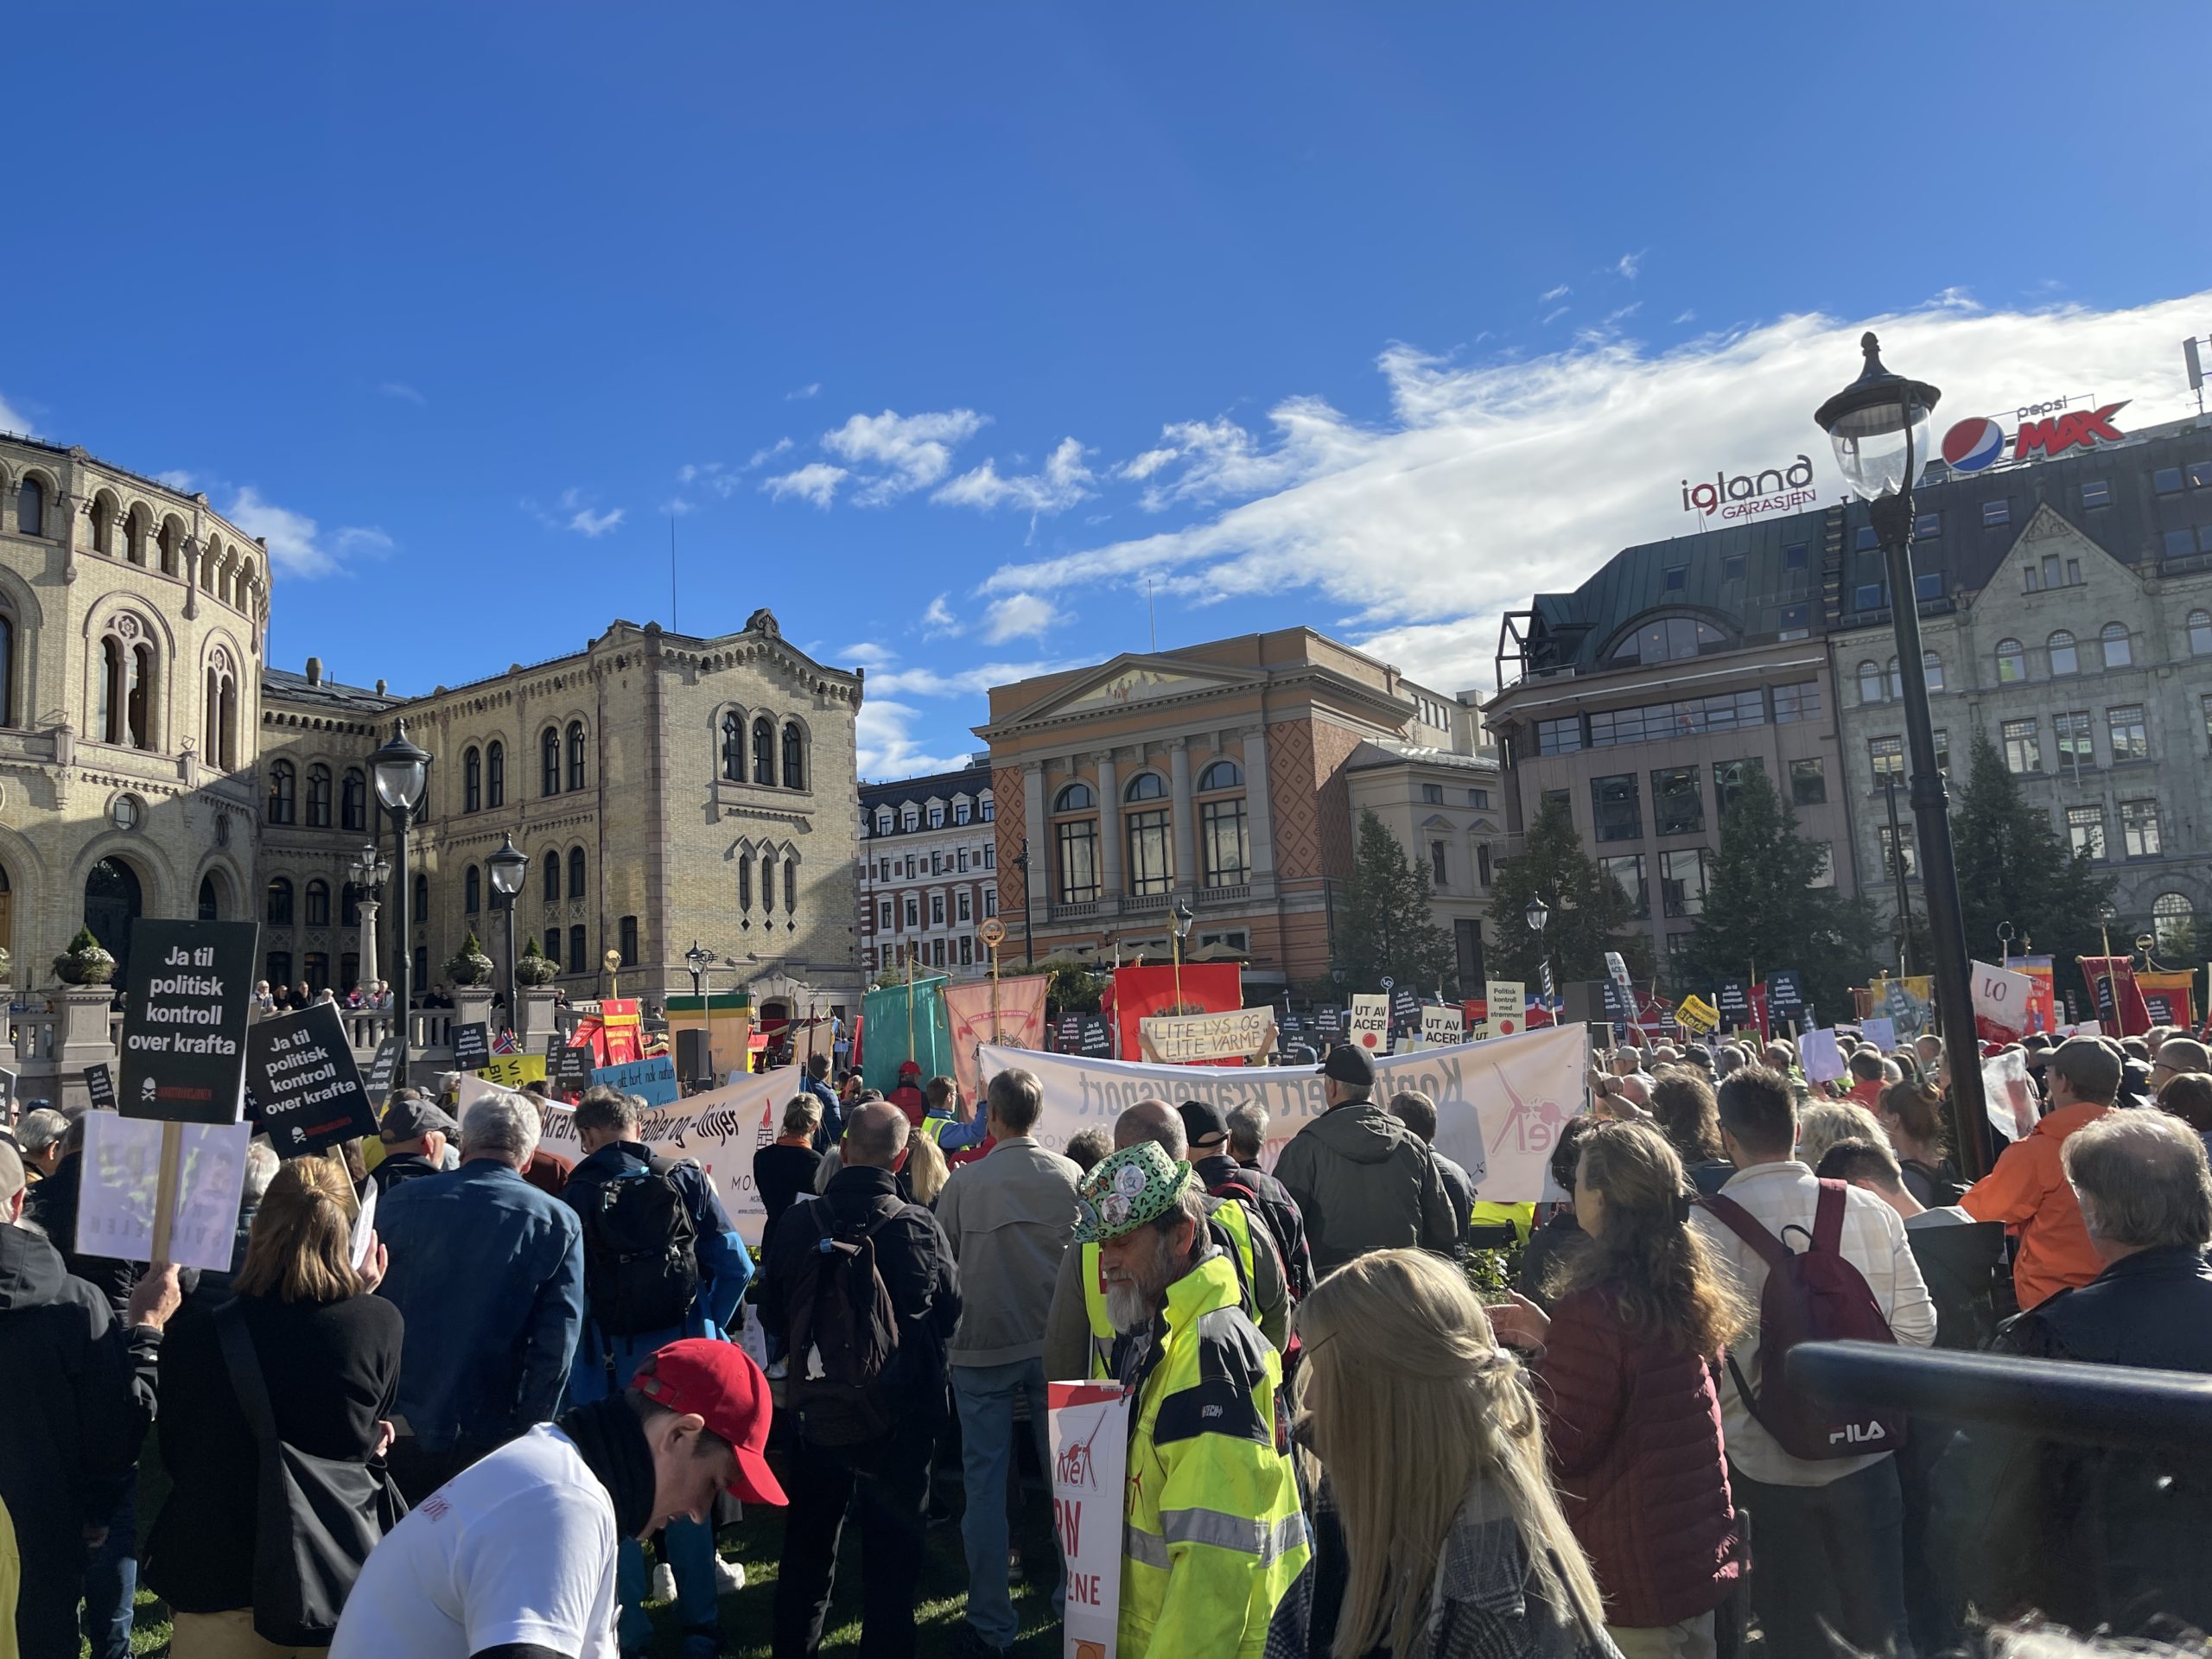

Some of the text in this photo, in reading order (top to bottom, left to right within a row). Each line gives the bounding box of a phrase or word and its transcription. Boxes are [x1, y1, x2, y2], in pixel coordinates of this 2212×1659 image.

[2017, 395, 2068, 422] pepsi
[2014, 399, 2133, 461] MAX
[1681, 454, 1814, 516] igland
[1722, 489, 1816, 519] GARASJEN
[165, 946, 214, 967] Ja til
[150, 975, 224, 997] politisk
[1985, 977, 2006, 1001] LO
[146, 1002, 222, 1025] kontroll
[1355, 1006, 1386, 1017] UT AV
[1084, 1028, 1103, 1037] politisk
[1204, 1018, 1231, 1036] LYS
[1241, 1014, 1259, 1032] OG
[1353, 1019, 1386, 1030] ACER!
[1426, 1018, 1459, 1031] UT AV
[1476, 1032, 1488, 1040] UT
[128, 1033, 236, 1055] over krafta
[270, 1028, 311, 1052] Ja til
[1166, 1039, 1205, 1057] LITE
[1425, 1032, 1460, 1045] ACER!
[265, 1046, 329, 1077] politisk
[270, 1063, 337, 1093] kontroll
[265, 1096, 302, 1116] over
[303, 1080, 358, 1105] krafta
[668, 1115, 692, 1149] og
[690, 1103, 739, 1147] -linjer
[1829, 1421, 1885, 1444] FILA
